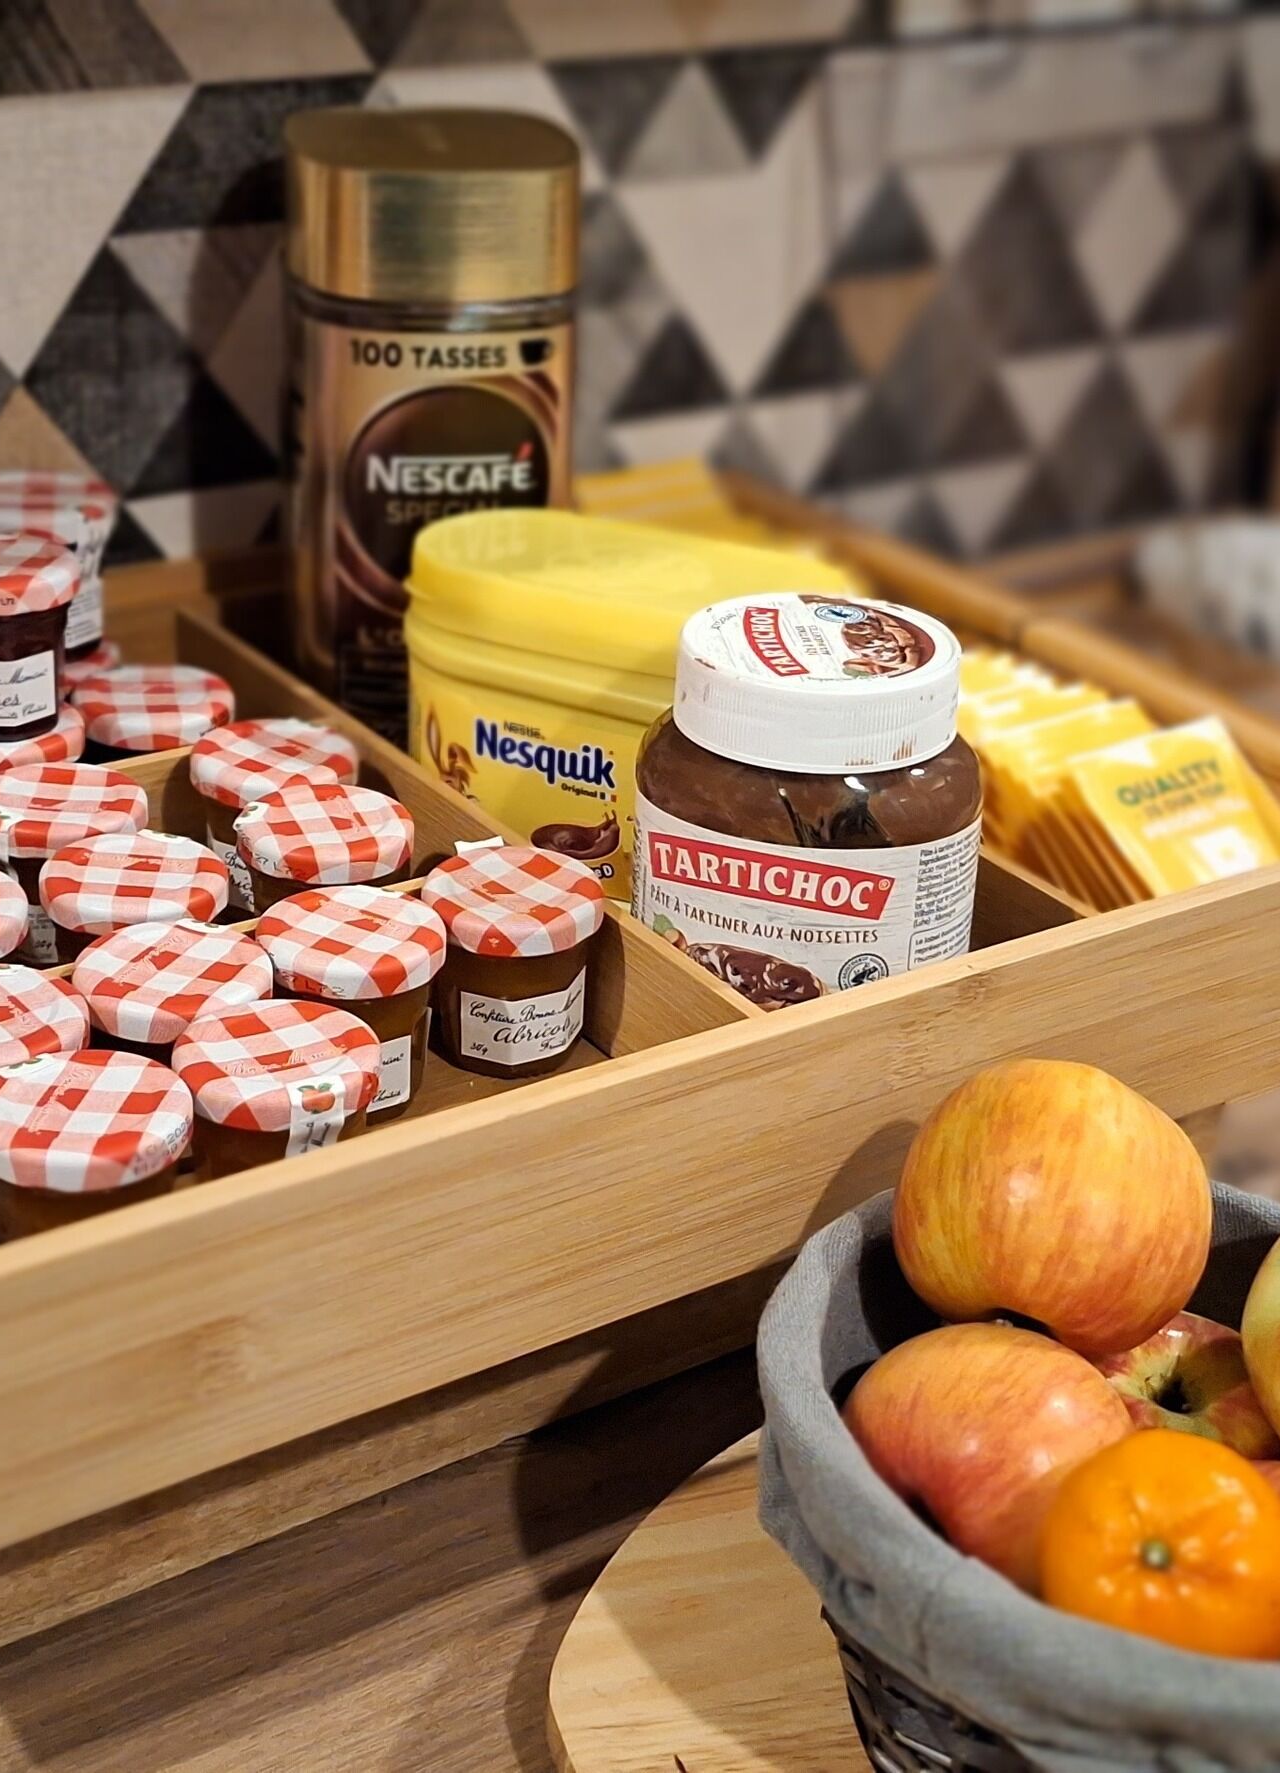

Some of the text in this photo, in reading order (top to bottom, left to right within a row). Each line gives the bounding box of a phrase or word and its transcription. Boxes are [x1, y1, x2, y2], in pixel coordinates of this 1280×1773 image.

[350, 340, 506, 368] 100 TASSES
[366, 442, 535, 494] NESCAFÉ
[750, 609, 802, 675] TARTICHOC
[475, 718, 616, 789] Nesquik
[561, 783, 598, 799] Original
[1116, 759, 1220, 806] QUALITY
[654, 841, 875, 912] TARTICHOC
[650, 884, 879, 944] PÂTE À TARTINER AUX NOISETTES
[469, 1001, 557, 1024] Confiture Bonne
